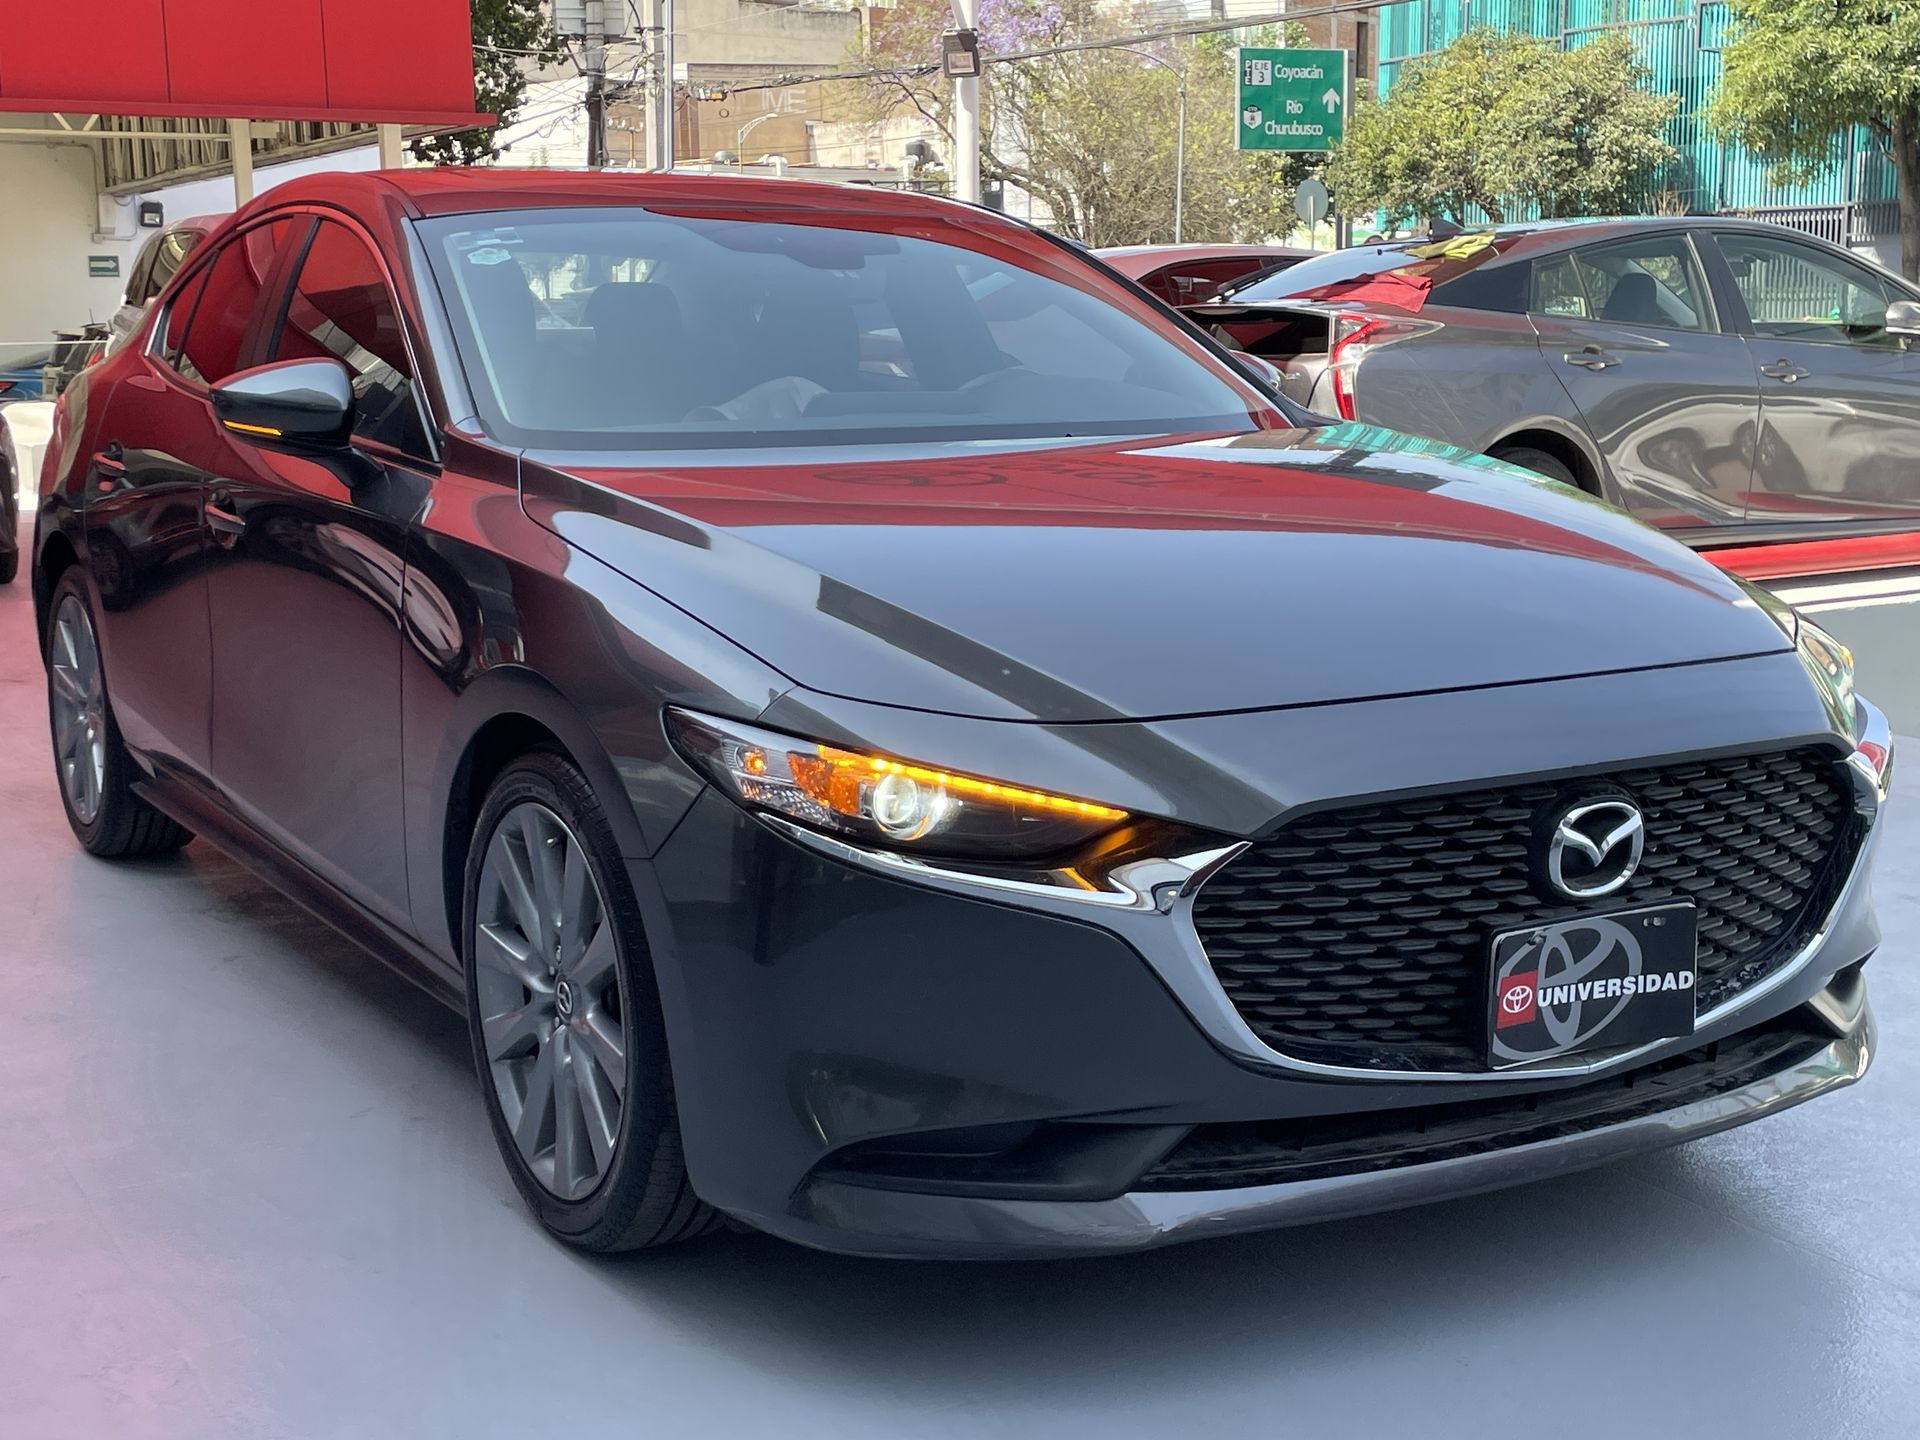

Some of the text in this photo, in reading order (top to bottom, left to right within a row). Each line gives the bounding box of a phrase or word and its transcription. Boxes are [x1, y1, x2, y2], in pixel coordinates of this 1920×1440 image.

[1254, 62, 1269, 70] EJE
[1274, 64, 1323, 82] Coyoacán
[1258, 71, 1265, 83] 3
[1264, 120, 1323, 135] Churubusco
[1537, 970, 1694, 1008] UNIVERSIDAD
